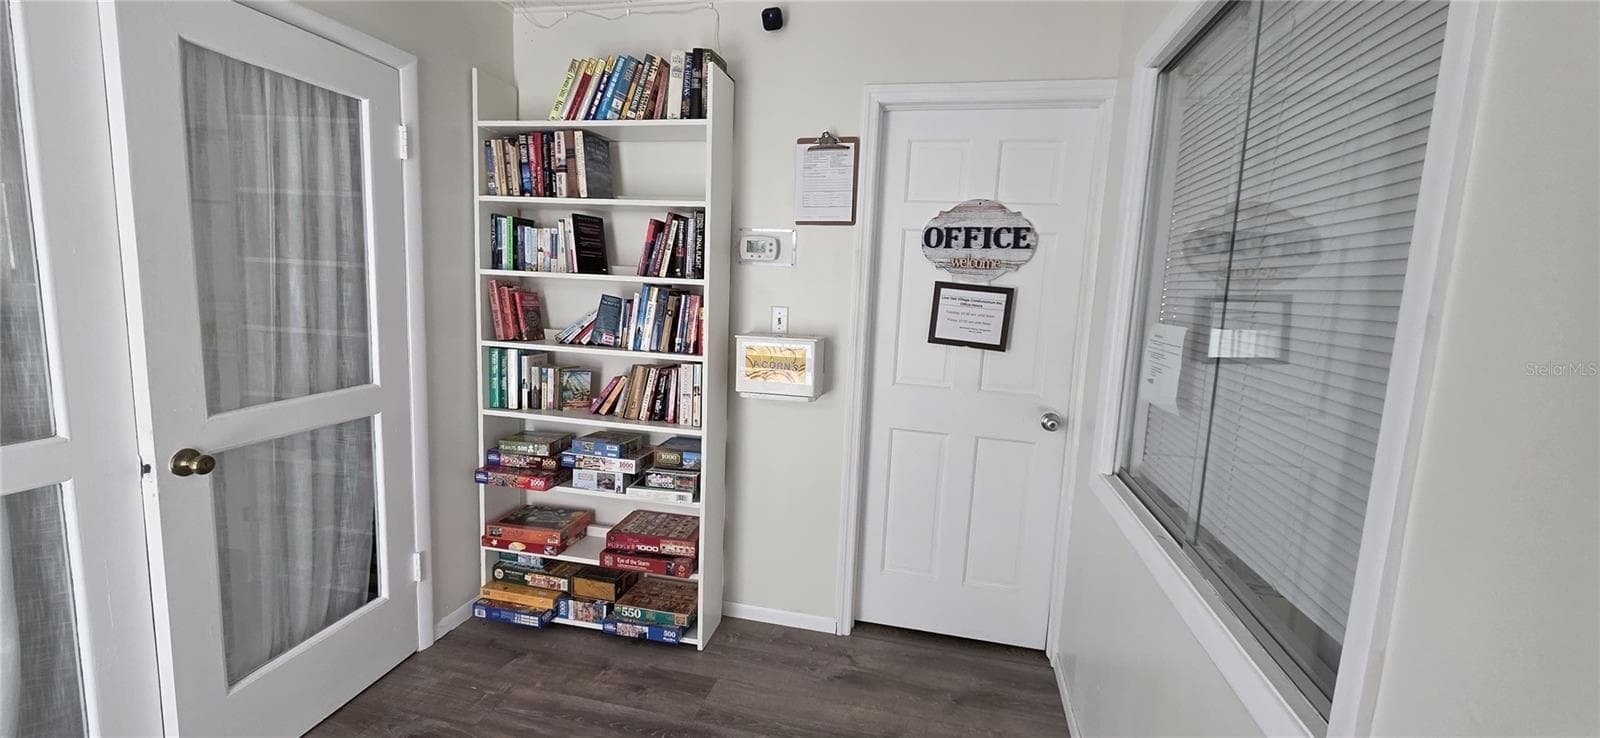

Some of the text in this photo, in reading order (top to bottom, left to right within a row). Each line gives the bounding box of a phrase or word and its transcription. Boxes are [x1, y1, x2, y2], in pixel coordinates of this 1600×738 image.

[684, 70, 692, 97] HIGGINS
[924, 227, 1033, 249] OFFICE
[951, 253, 1001, 269] welcome
[752, 359, 799, 372] ACORNS
[542, 458, 557, 467] 1000
[620, 460, 634, 469] 1000
[530, 479, 545, 488] 1000
[636, 544, 659, 552] 1000
[637, 559, 650, 567] Storm
[621, 607, 641, 618] 550
[663, 630, 676, 638] 500
